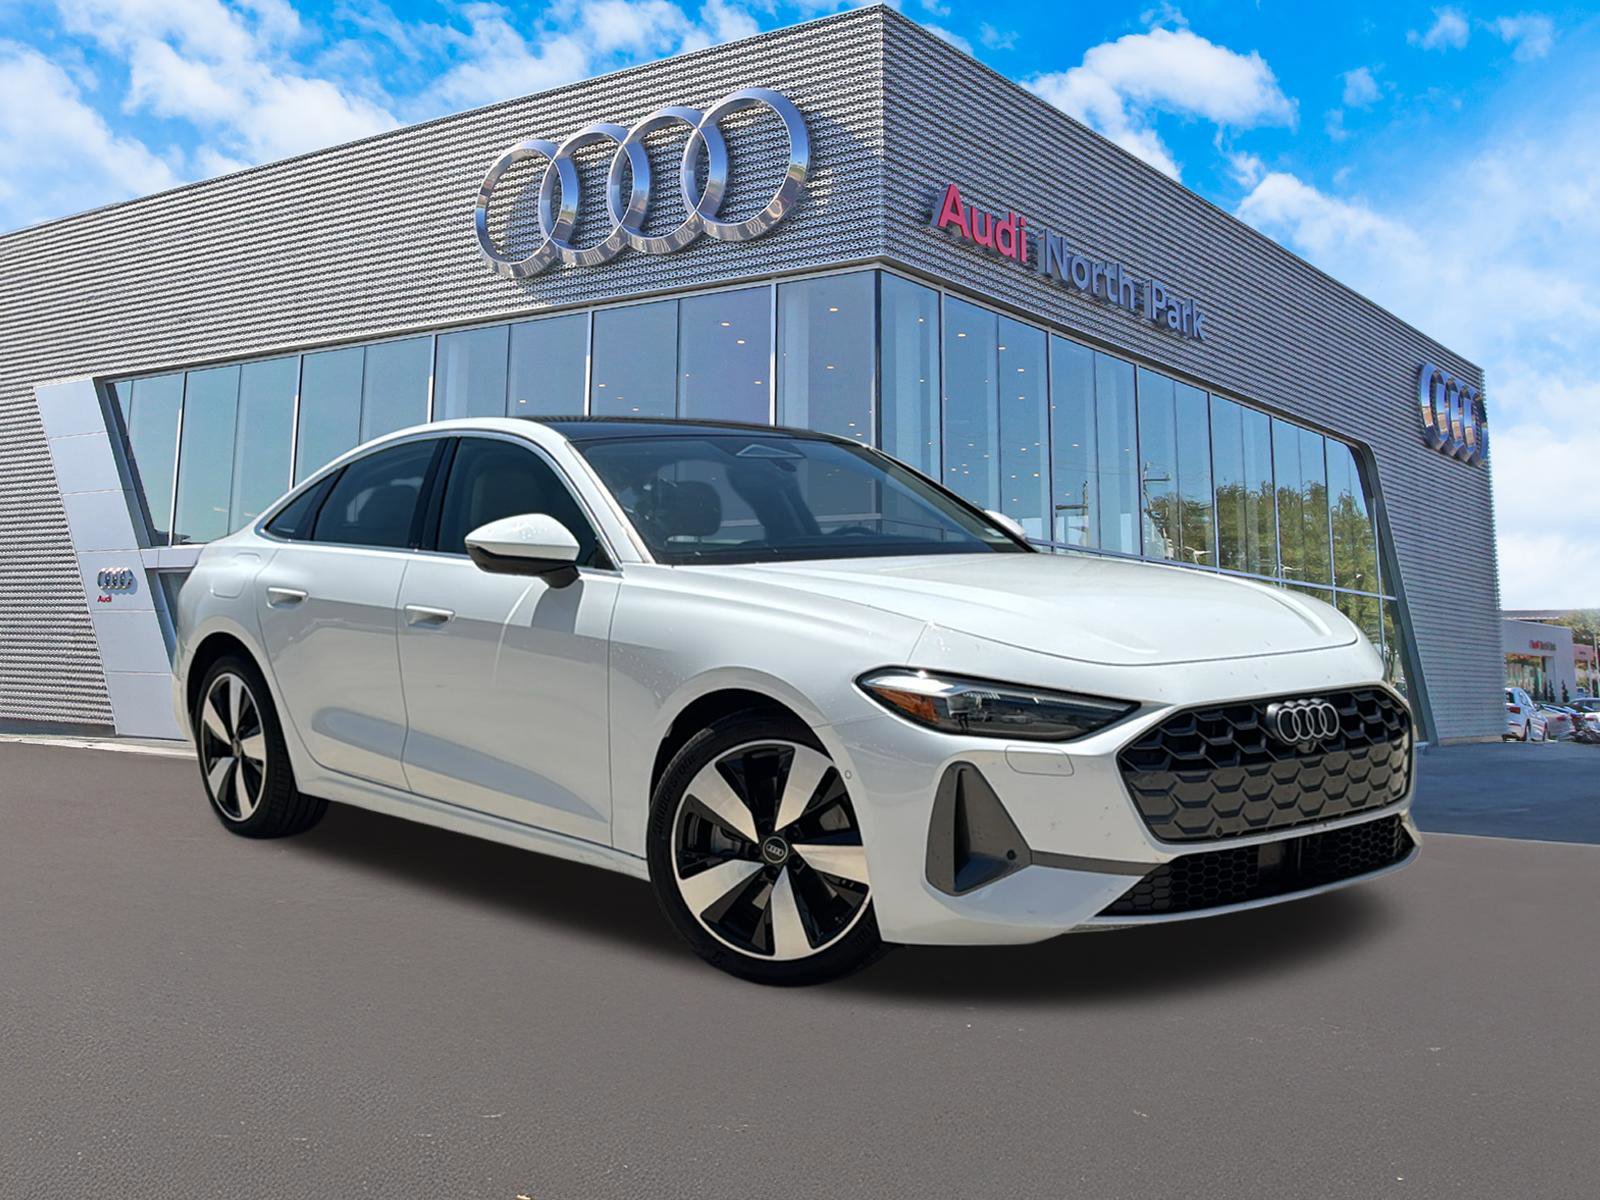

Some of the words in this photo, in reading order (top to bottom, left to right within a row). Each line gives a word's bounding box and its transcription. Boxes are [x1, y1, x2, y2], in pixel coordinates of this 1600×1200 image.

[934, 183, 1028, 263] Audi
[1040, 229, 1136, 313] North
[1146, 278, 1207, 341] Park
